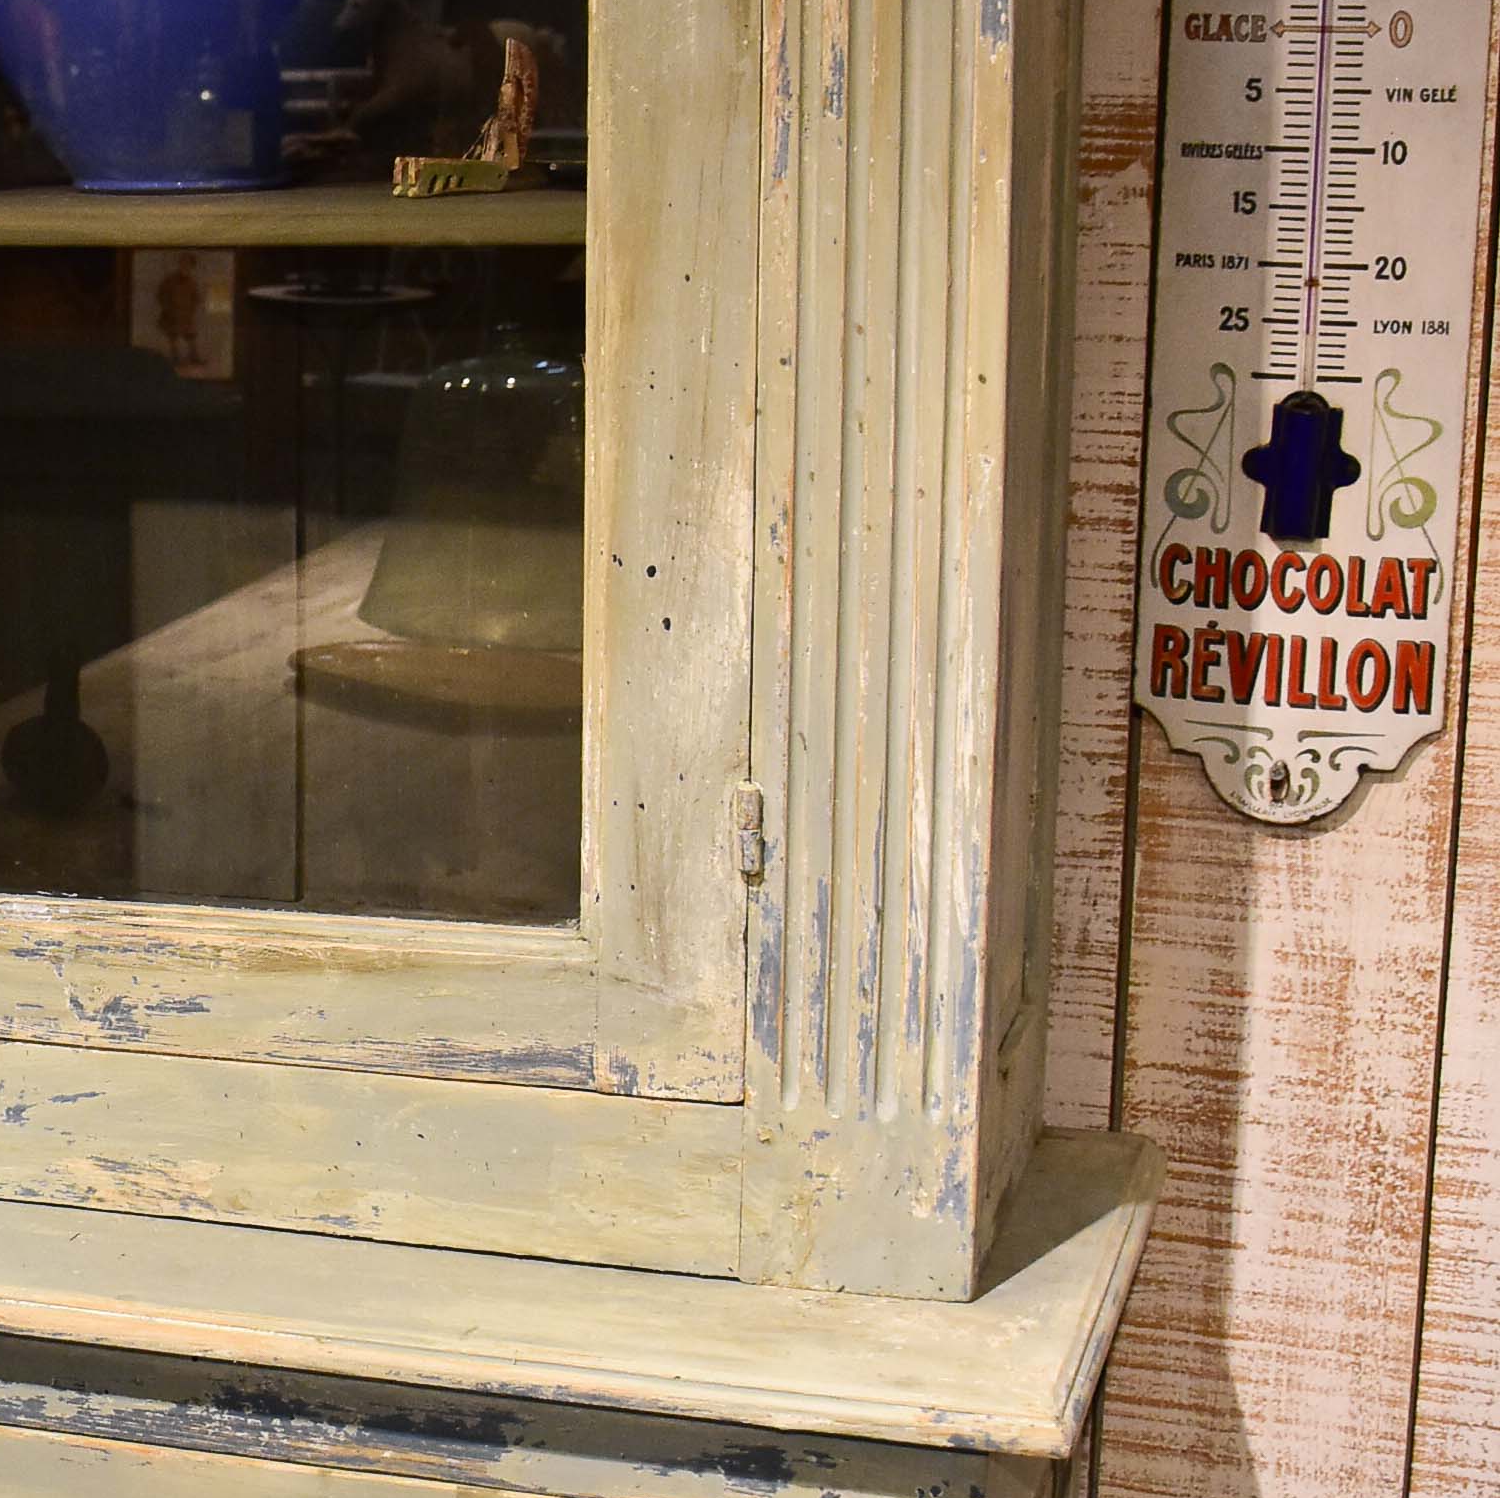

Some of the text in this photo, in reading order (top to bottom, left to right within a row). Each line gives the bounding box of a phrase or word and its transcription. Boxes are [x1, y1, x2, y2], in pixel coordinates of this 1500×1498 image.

[1184, 12, 1267, 42] GLACE
[1389, 10, 1414, 48] 0
[1245, 78, 1263, 102] 5
[1386, 85, 1457, 103] VIN GELÉ
[1382, 140, 1408, 165] 10
[1232, 191, 1257, 215] 15
[1175, 253, 1249, 271] PARIS 1871
[1374, 256, 1407, 280] 20
[1220, 307, 1249, 332] 25
[1373, 320, 1412, 335] LYON
[1159, 542, 1436, 620] CHOCOLAT
[1150, 619, 1434, 715] RÉVILLON
